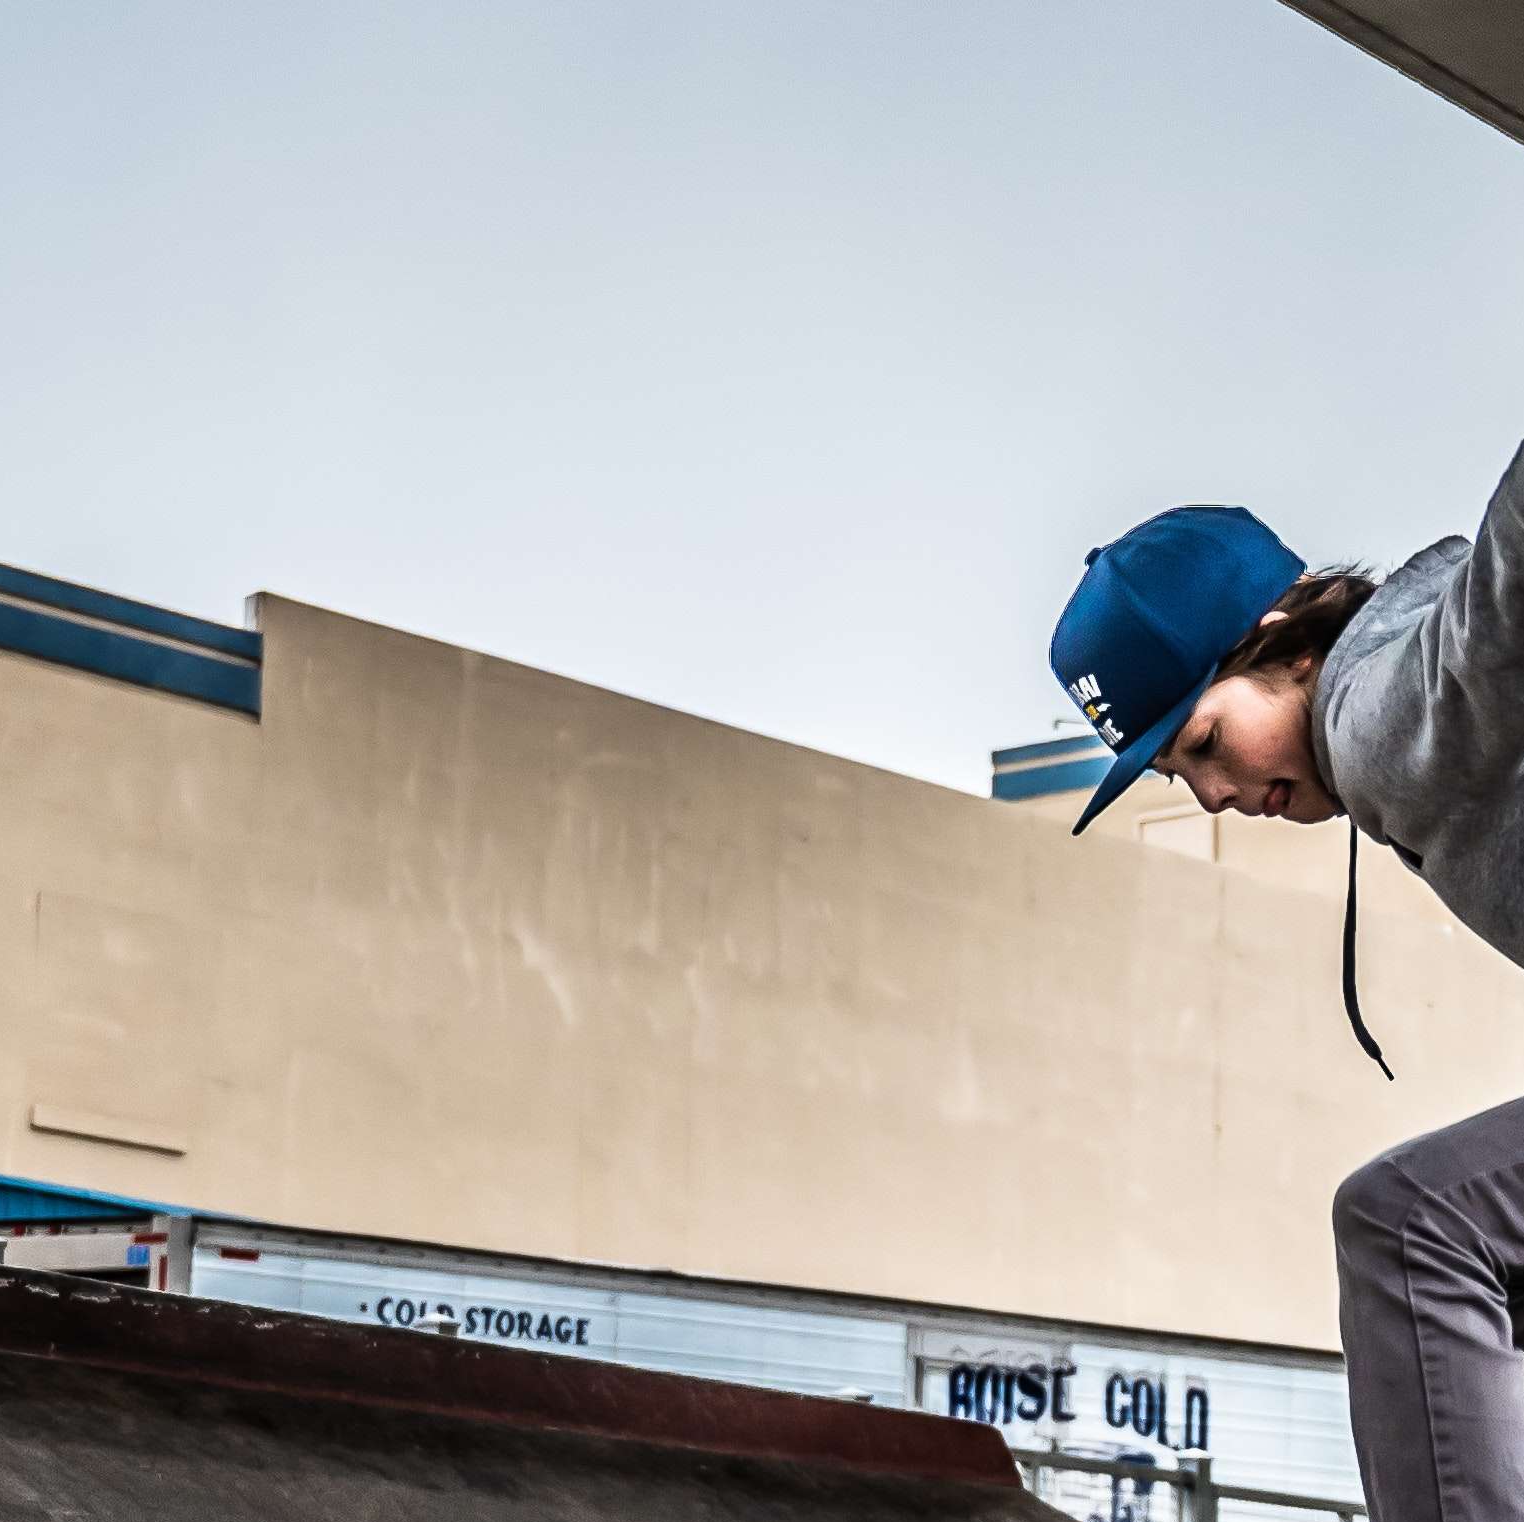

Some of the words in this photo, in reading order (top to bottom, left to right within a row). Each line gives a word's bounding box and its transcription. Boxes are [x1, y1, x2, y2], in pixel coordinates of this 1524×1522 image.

[466, 1307, 590, 1345] STORAGE
[949, 1362, 1077, 1424] BOISE
[1106, 1372, 1209, 1450] COLD
